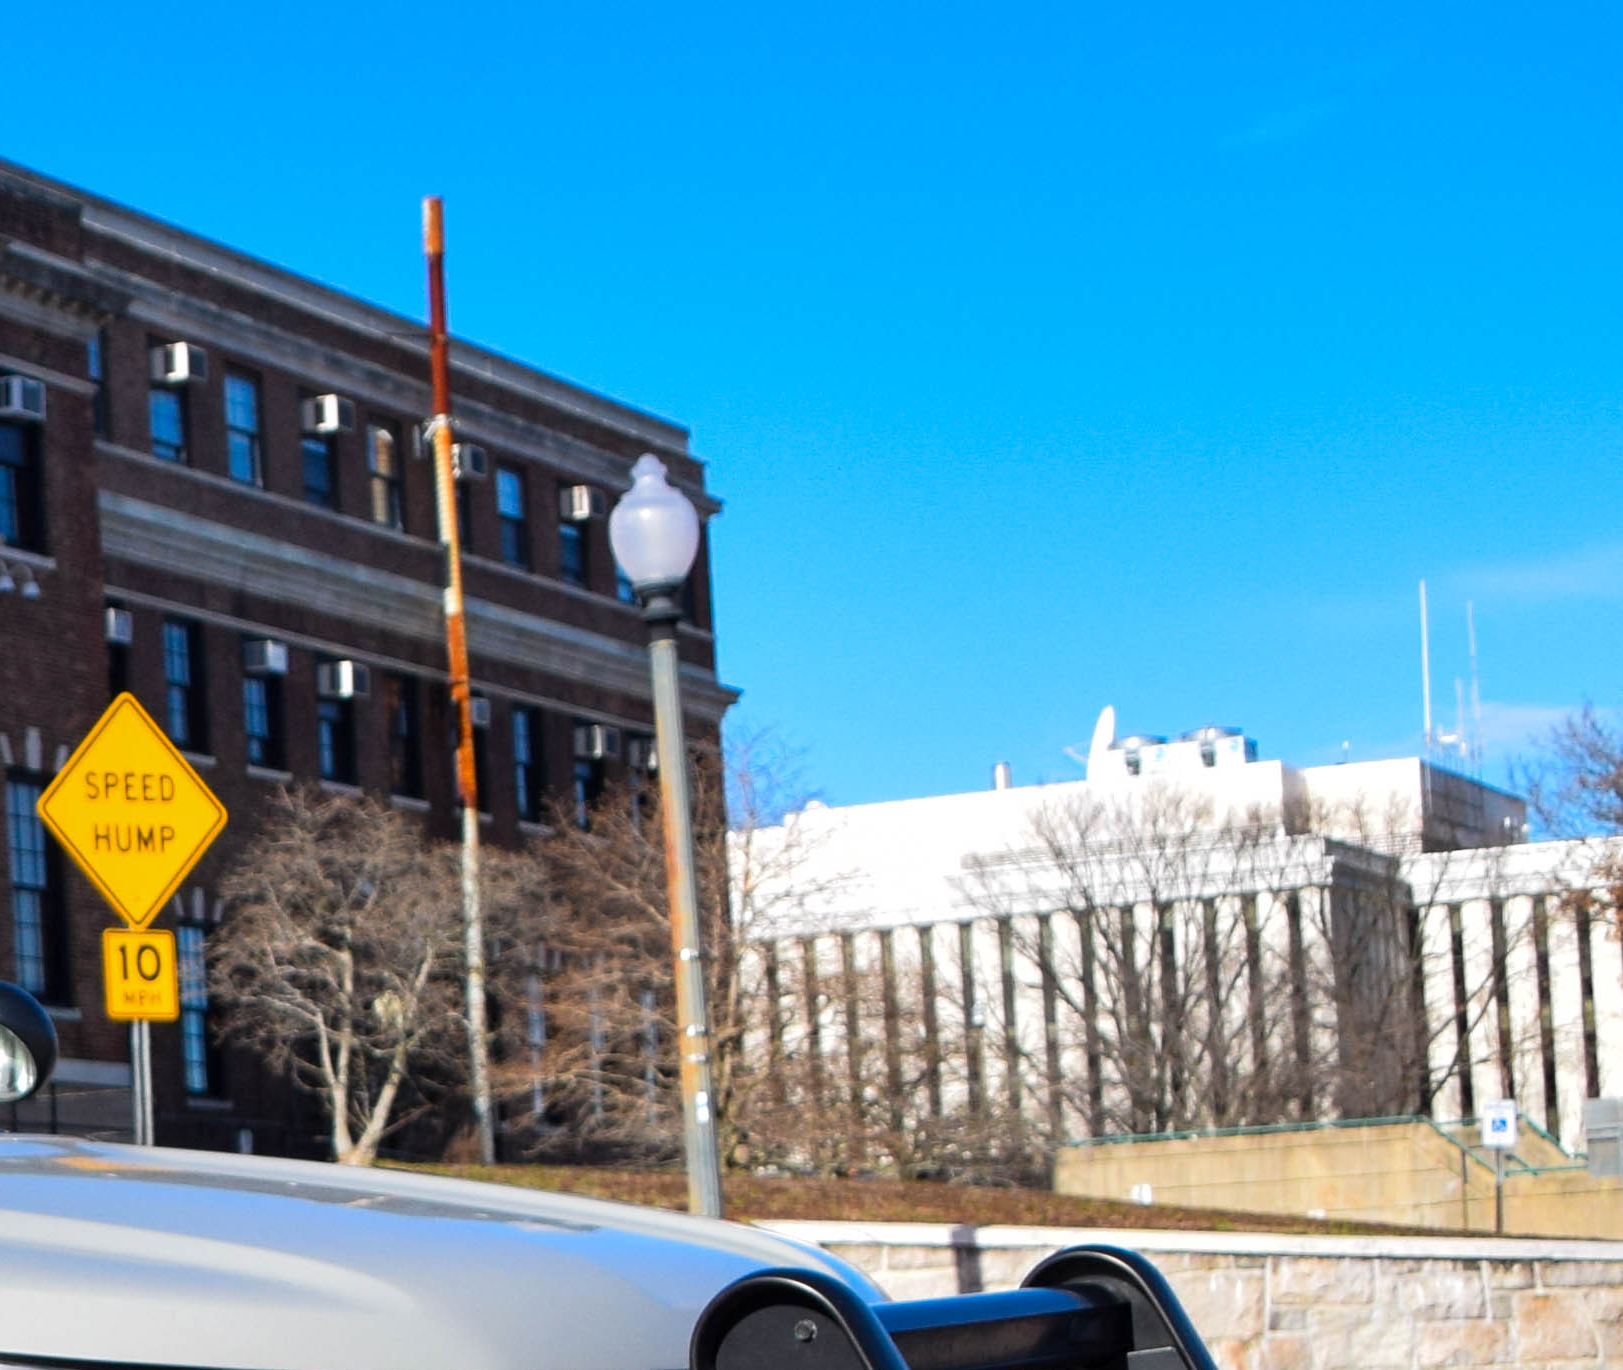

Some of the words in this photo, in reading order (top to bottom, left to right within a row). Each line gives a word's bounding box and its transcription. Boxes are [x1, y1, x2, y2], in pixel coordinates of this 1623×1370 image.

[85, 771, 175, 802] SPEED
[94, 823, 175, 853] HUMP
[119, 944, 161, 981] 10
